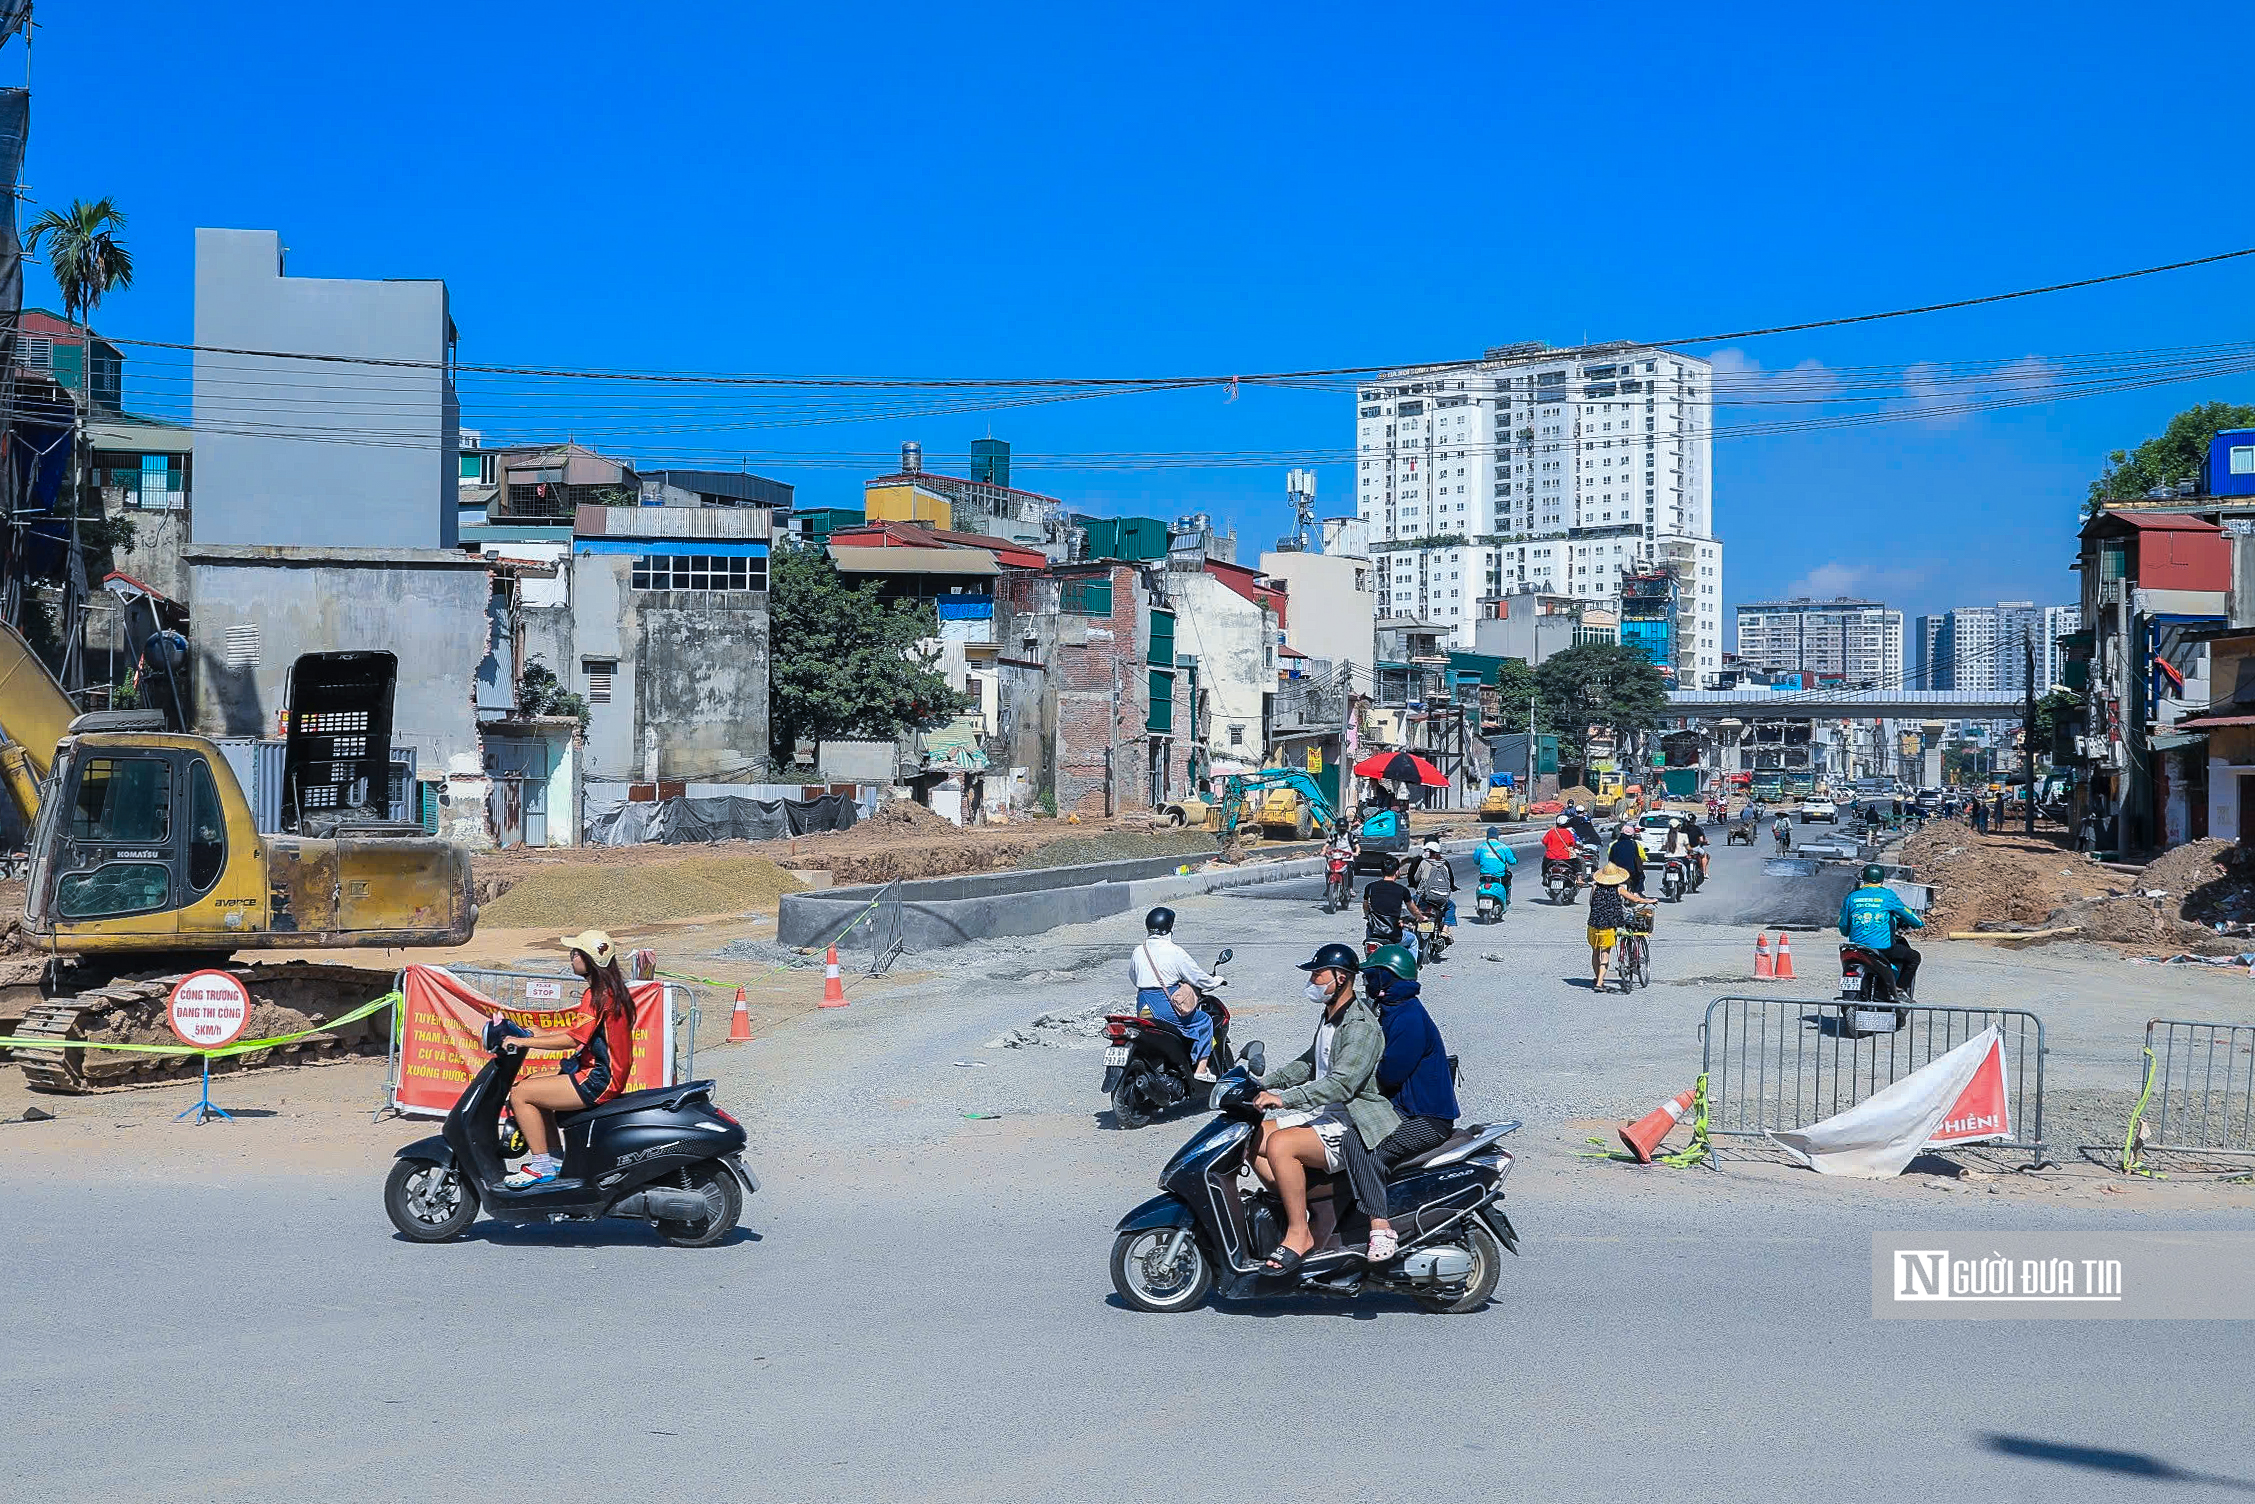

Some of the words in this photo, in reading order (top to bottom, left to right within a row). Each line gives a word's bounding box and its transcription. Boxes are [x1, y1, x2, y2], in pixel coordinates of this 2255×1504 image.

[116, 850, 159, 859] KOMATSU
[180, 987, 204, 1001] CÔNG
[202, 1007, 216, 1018] THI
[217, 1006, 241, 1019] CÔNG
[413, 1029, 441, 1043] THAM
